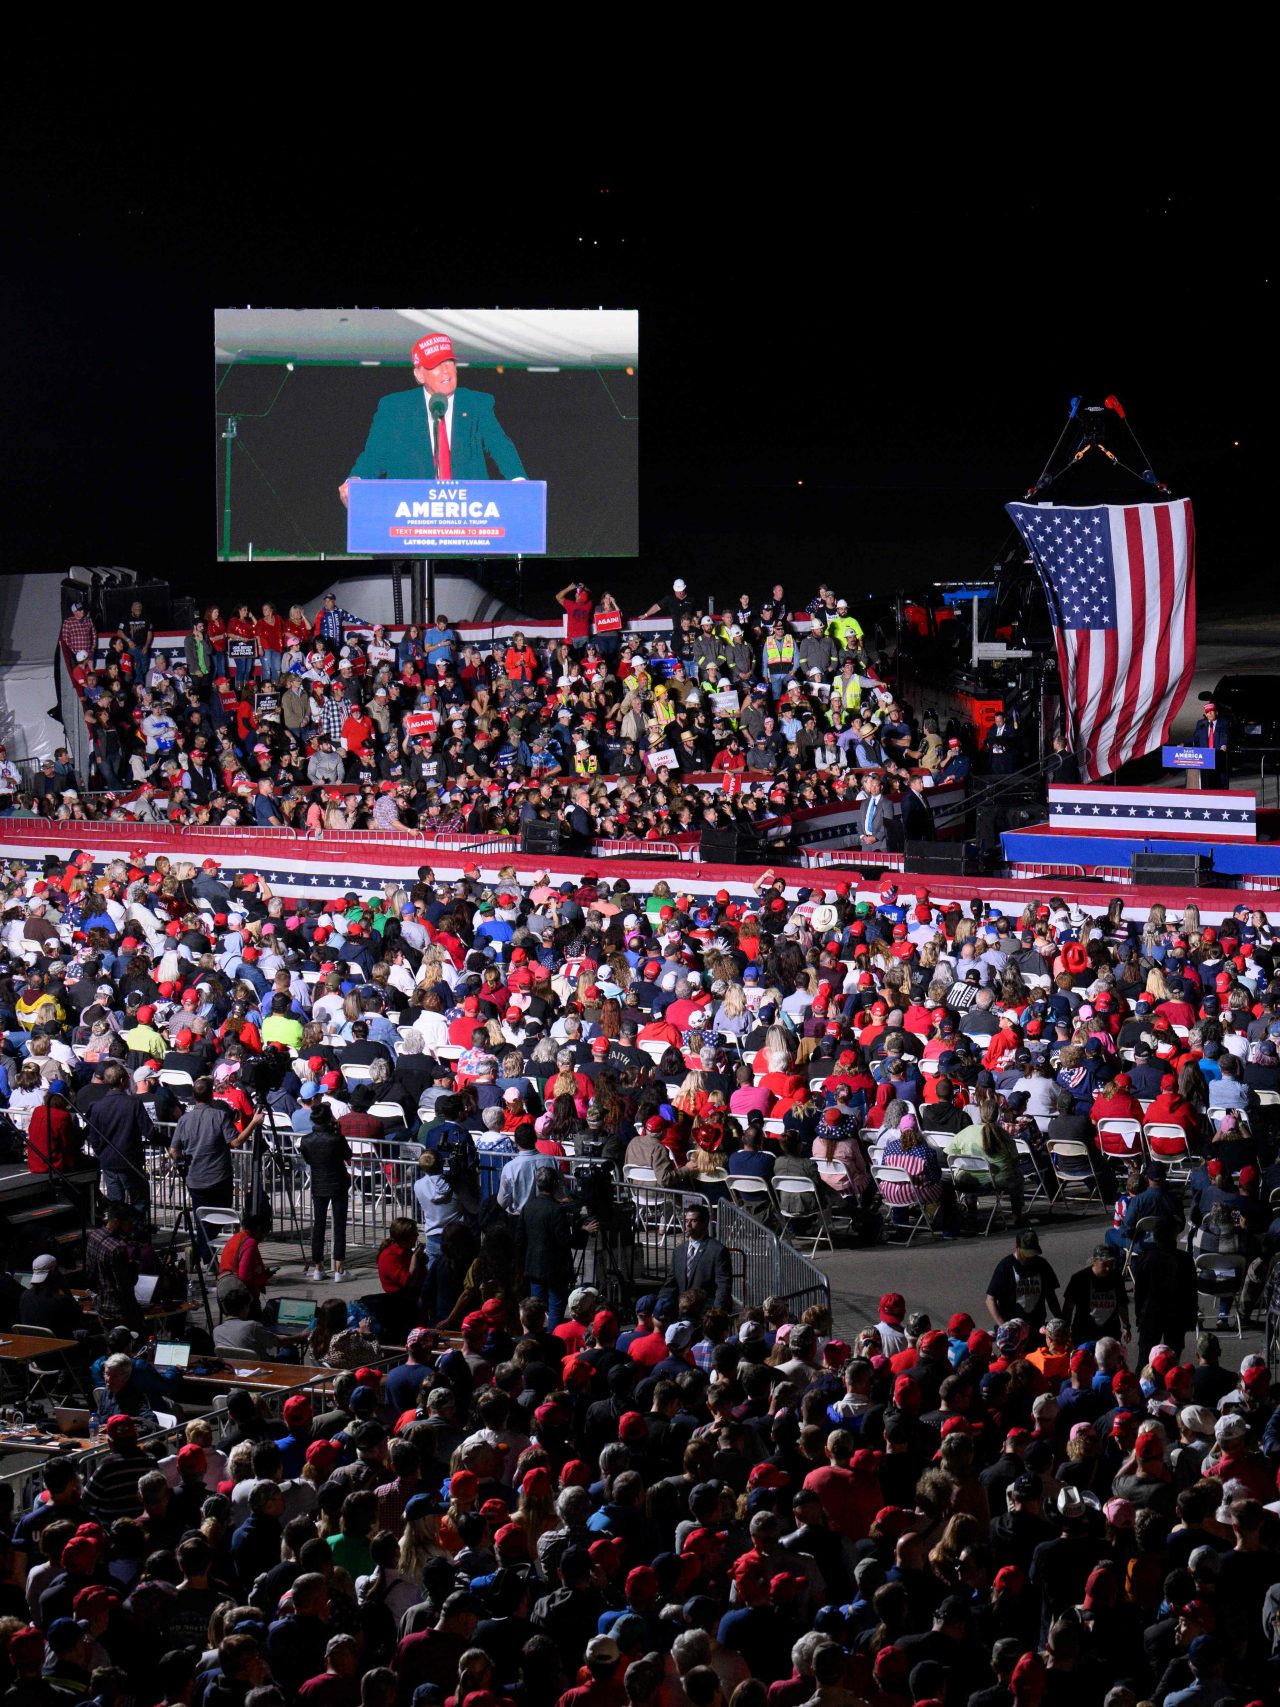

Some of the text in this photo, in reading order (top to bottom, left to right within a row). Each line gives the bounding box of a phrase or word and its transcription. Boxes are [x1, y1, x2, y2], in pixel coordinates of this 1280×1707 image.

[428, 489, 467, 500] SAVE
[395, 502, 500, 518] AMERICA
[597, 617, 619, 626] AGAIN!
[410, 720, 433, 728] AGAIN!
